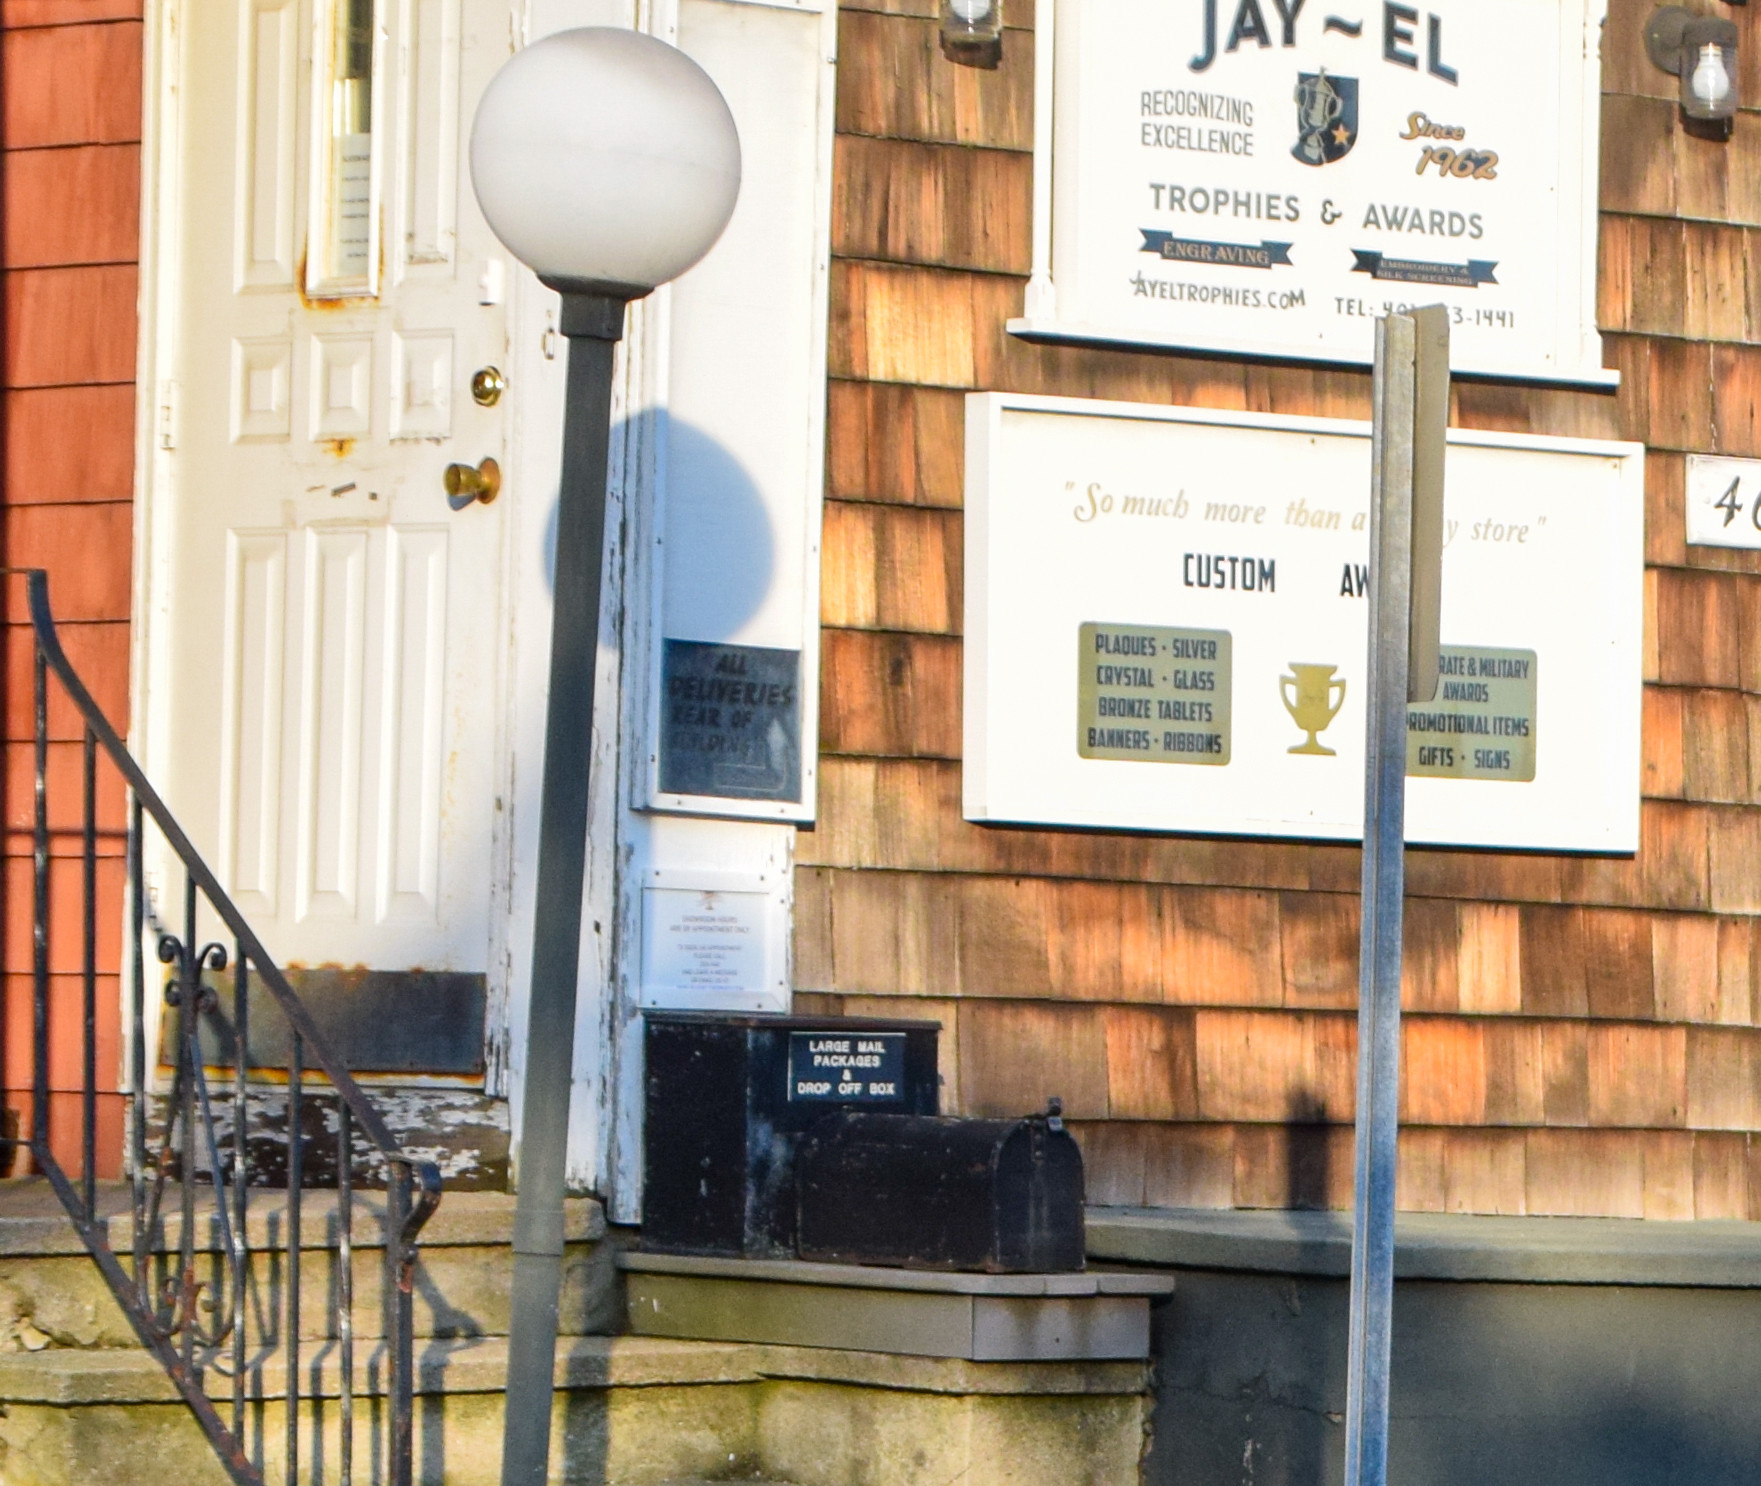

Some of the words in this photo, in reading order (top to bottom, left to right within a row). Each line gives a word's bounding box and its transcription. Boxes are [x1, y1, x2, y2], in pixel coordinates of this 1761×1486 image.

[1141, 90, 1253, 127] RECOGNIZING
[1399, 111, 1465, 140] Since
[1141, 123, 1253, 156] EXCELLENCE
[1415, 145, 1498, 180] 1962
[1149, 183, 1300, 222] TROPHIES
[1319, 199, 1342, 225] &
[1362, 203, 1483, 239] AWARDS
[1163, 241, 1270, 264] ENGRAVING
[1334, 297, 1374, 317] TEL:
[1121, 489, 1189, 519] much
[1204, 501, 1266, 524] more
[1284, 497, 1341, 530] than
[1351, 511, 1366, 531] a
[1183, 552, 1276, 593] CUSTOM
[1095, 633, 1156, 657] PLAQUES
[1172, 638, 1217, 660] SILVER
[715, 653, 747, 675] ALL
[1467, 657, 1477, 676] &
[1480, 659, 1529, 679] MILITARY
[1096, 665, 1154, 687] CRYSTAL
[1174, 669, 1215, 691] GLASS
[1443, 681, 1489, 703] AWARDS
[1098, 697, 1151, 718] BRONZE
[1157, 700, 1212, 722] TABLETS
[1493, 716, 1529, 737] ITEMS
[1088, 727, 1150, 750] BANNERS
[1163, 731, 1222, 754] RIBBONS
[1419, 746, 1454, 767] GIFTS
[1474, 748, 1510, 770] SIGNS
[809, 1040, 850, 1053] LARGE
[857, 1041, 886, 1053] MAIL
[813, 1055, 881, 1068] PACKAGES
[842, 1069, 851, 1080] &
[797, 1082, 832, 1095] DROP
[838, 1083, 862, 1095] OFF
[869, 1083, 895, 1095] BOX
